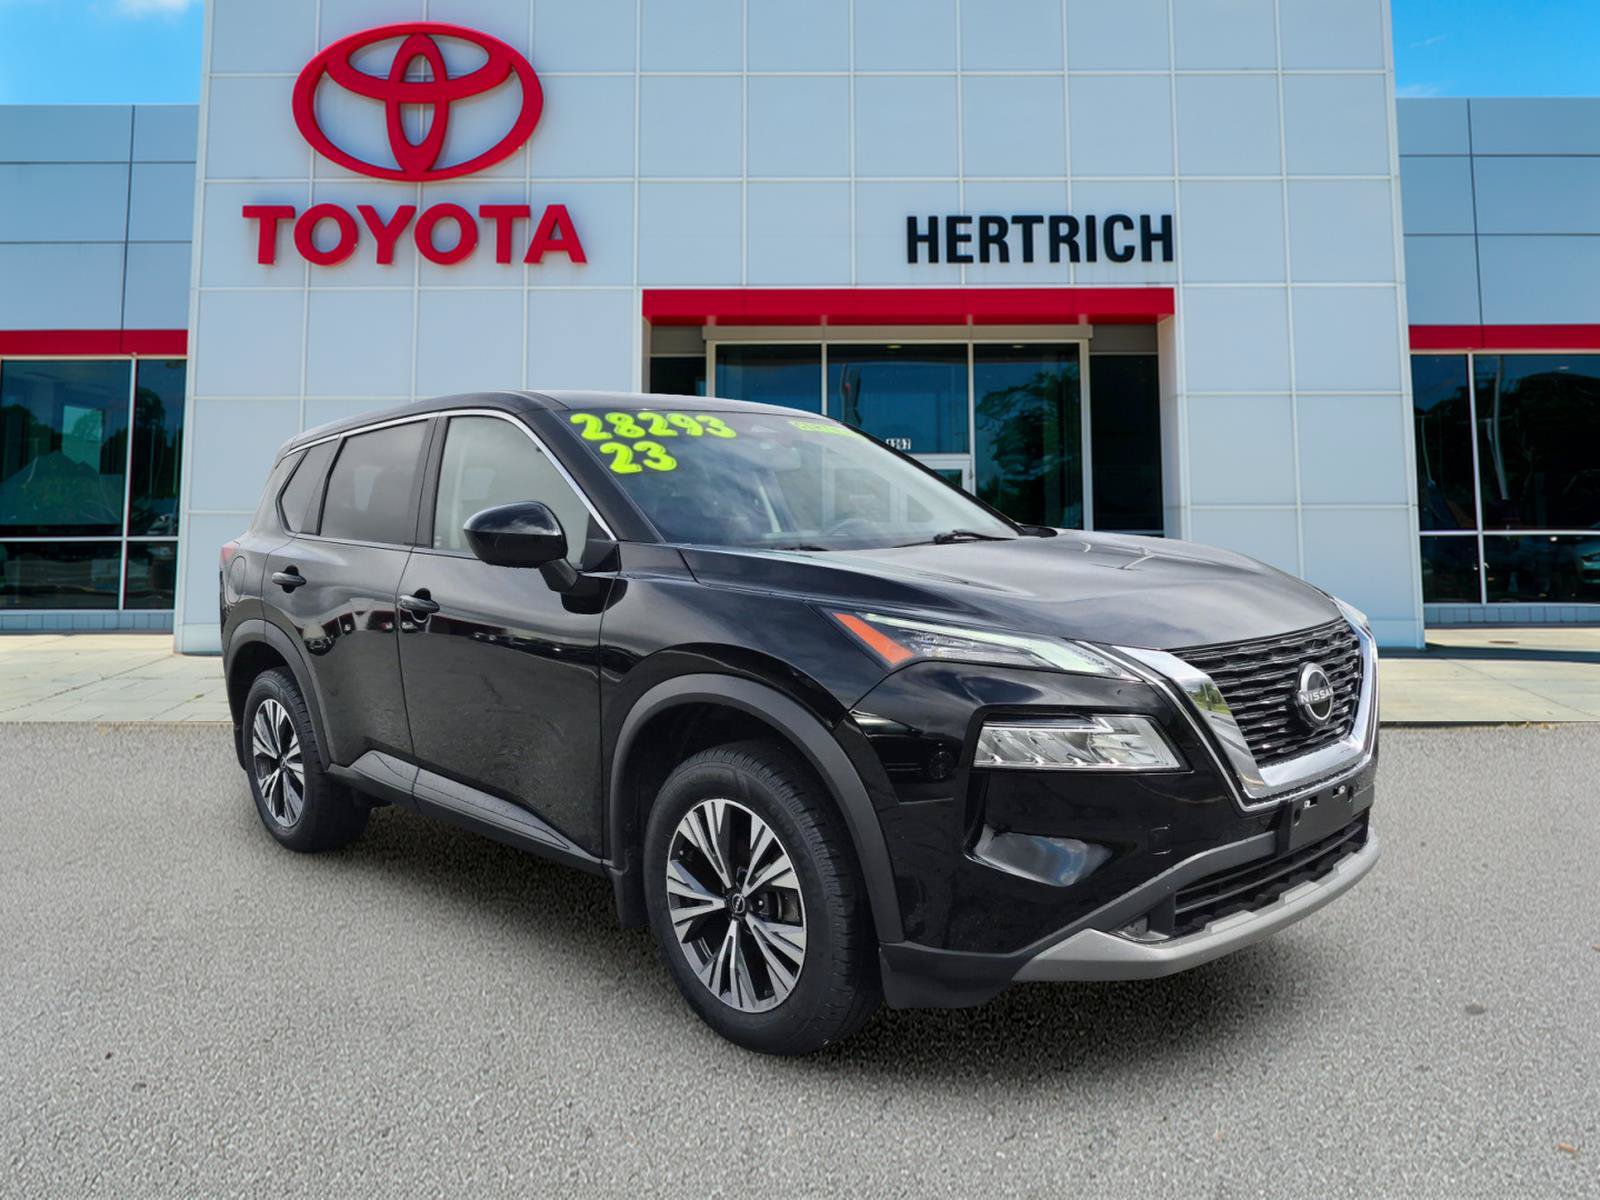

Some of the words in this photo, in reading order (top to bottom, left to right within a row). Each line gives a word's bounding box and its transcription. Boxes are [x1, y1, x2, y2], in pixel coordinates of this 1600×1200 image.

[243, 204, 587, 267] TOYOTA
[906, 214, 1174, 263] HERTRICH
[569, 412, 737, 441] 28293
[599, 441, 678, 475] 23
